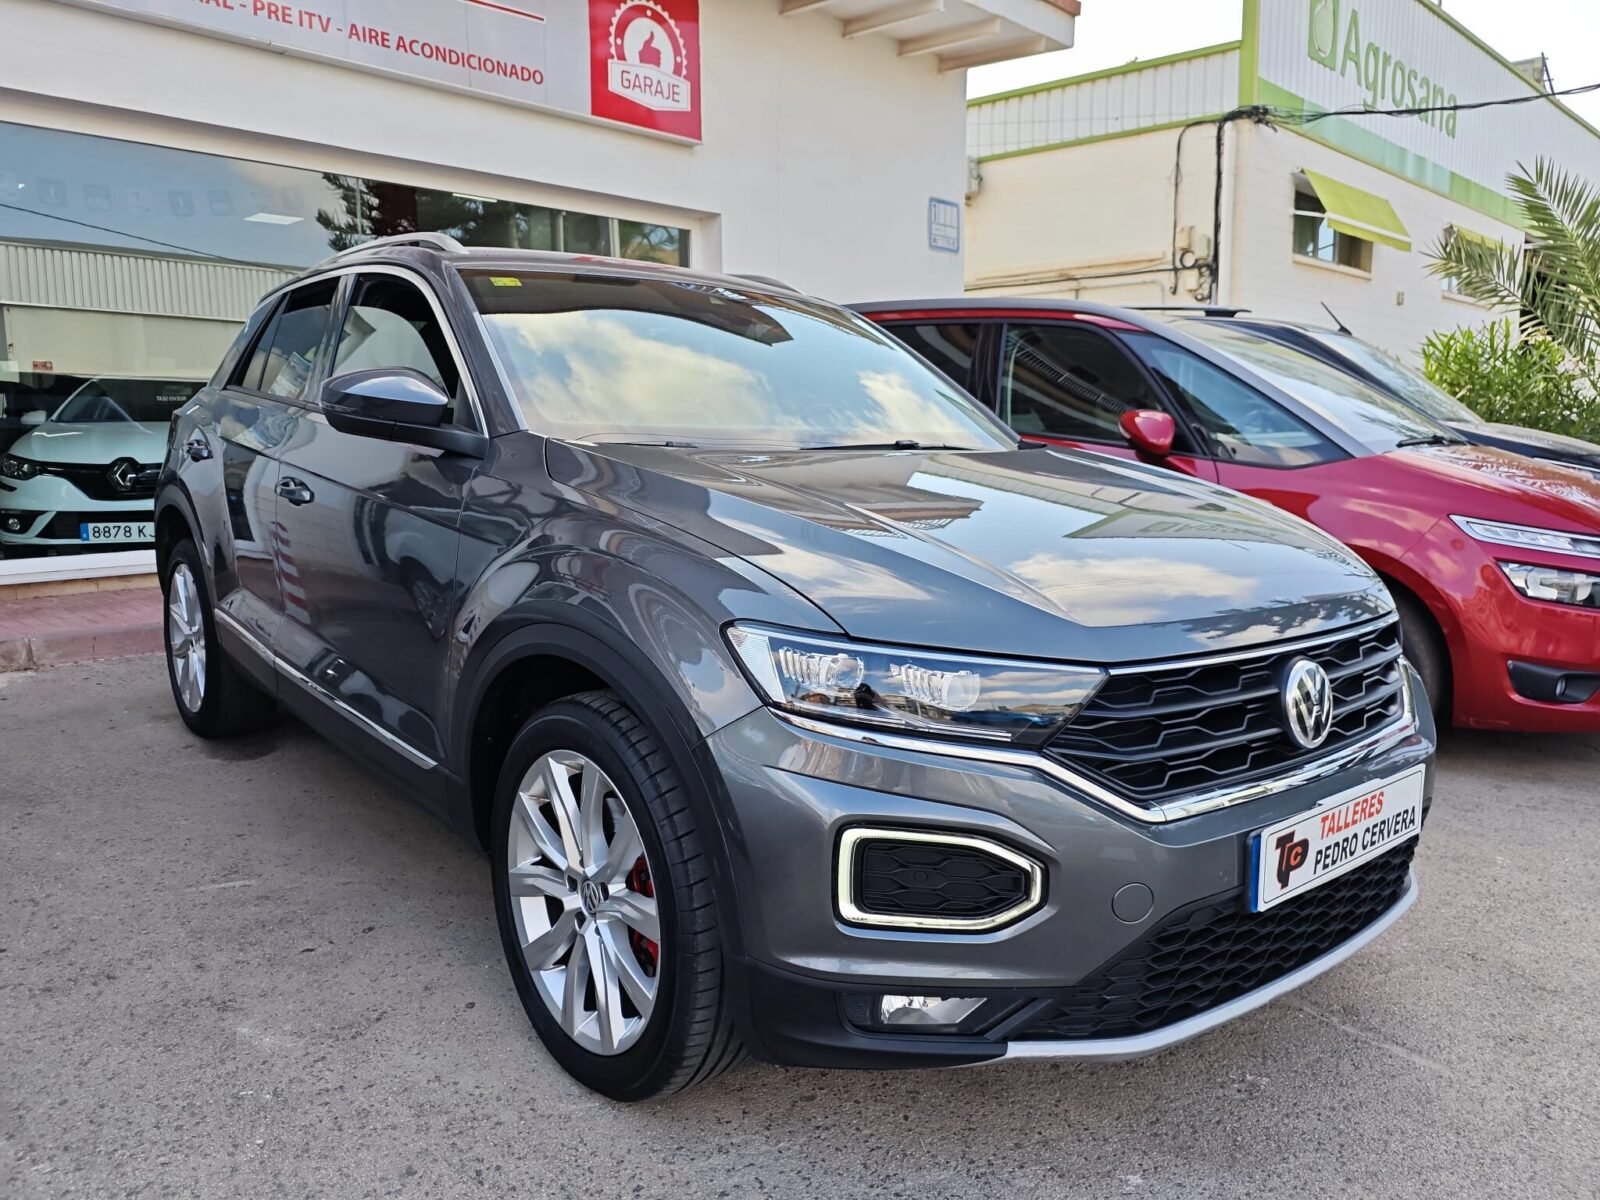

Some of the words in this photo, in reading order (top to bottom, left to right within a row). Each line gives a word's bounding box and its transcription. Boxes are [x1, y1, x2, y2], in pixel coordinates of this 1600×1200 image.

[252, 0, 293, 24] PRE
[298, 10, 332, 33] ITV
[348, 23, 391, 49] AIRE
[396, 35, 544, 85] ACONDICIONADO
[620, 70, 681, 104] GARAJE
[1340, 8, 1457, 139] Agrosana
[92, 525, 132, 538] 8878
[137, 525, 156, 538] K
[1313, 832, 1358, 875] PEDRO
[1361, 805, 1416, 850] CERVERA
[1320, 791, 1384, 840] TALLERES
